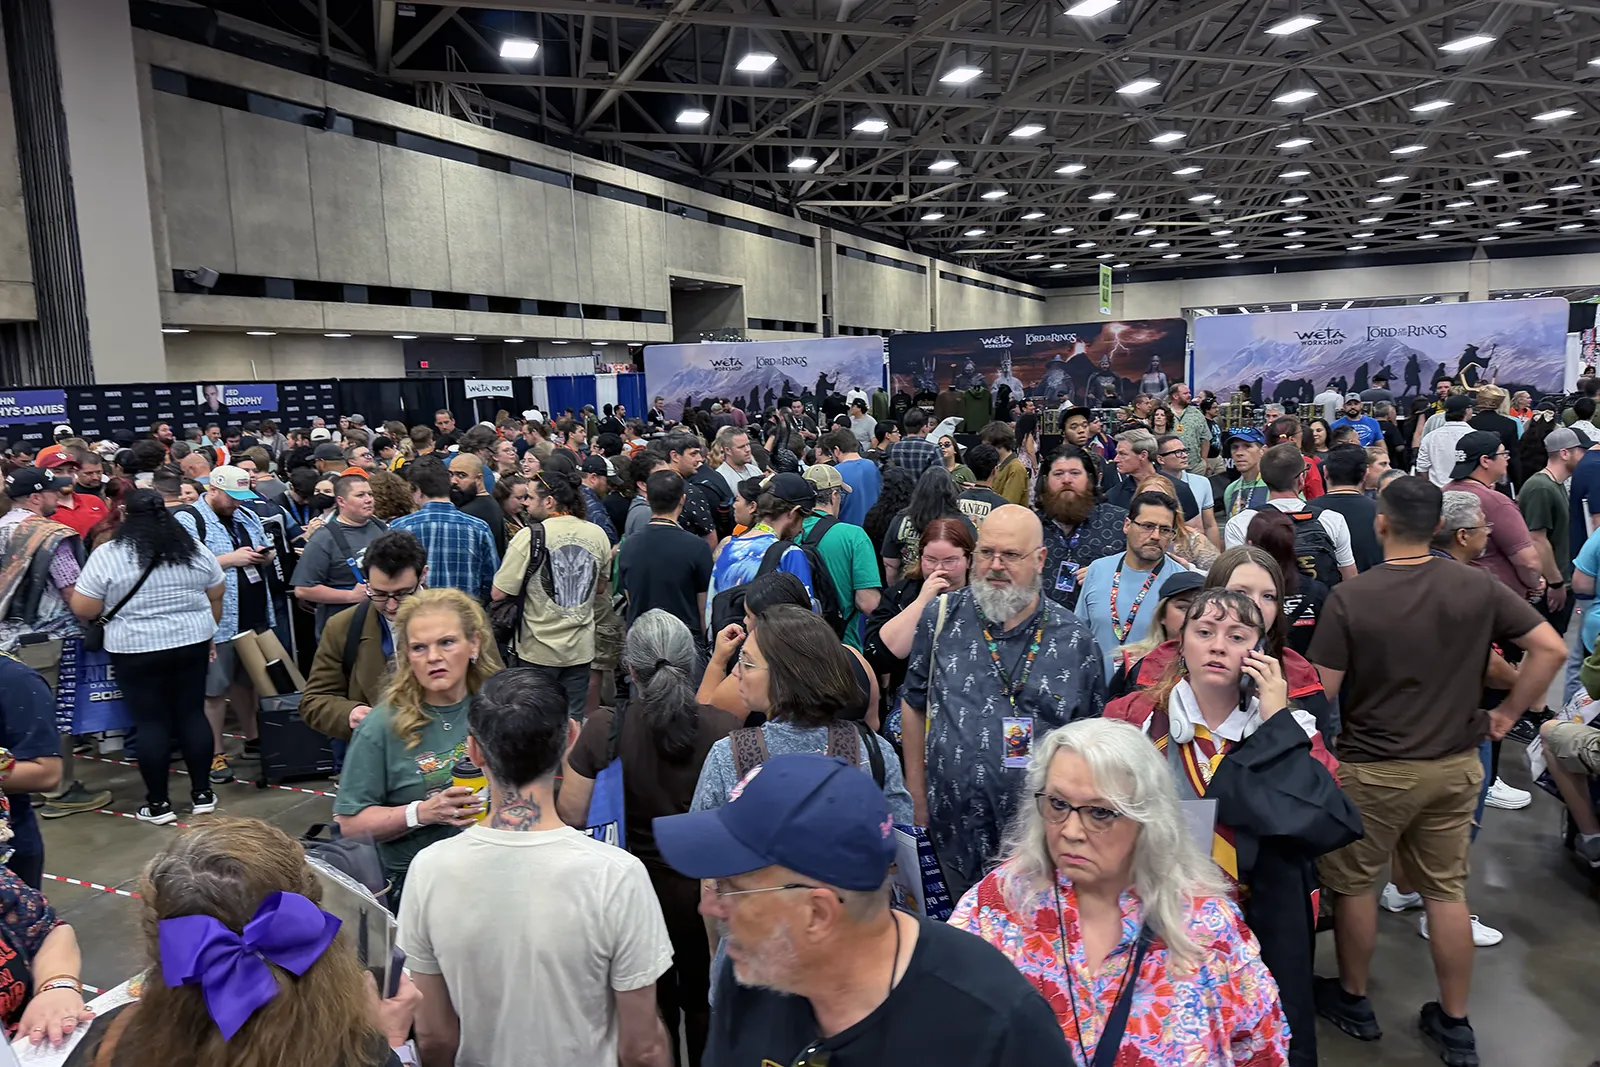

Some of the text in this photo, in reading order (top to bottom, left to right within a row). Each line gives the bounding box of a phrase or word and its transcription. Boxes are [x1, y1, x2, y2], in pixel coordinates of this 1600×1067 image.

[1366, 325, 1397, 342] LORD
[1407, 324, 1447, 338] RINGS
[1025, 333, 1046, 346] LORD
[1051, 333, 1077, 343] RINGS
[755, 356, 808, 369] LORD RINGS
[0, 397, 16, 405] HN
[226, 396, 263, 406] BROPHY
[0, 404, 65, 416] HYS-DAVIES
[88, 690, 124, 702] 202
